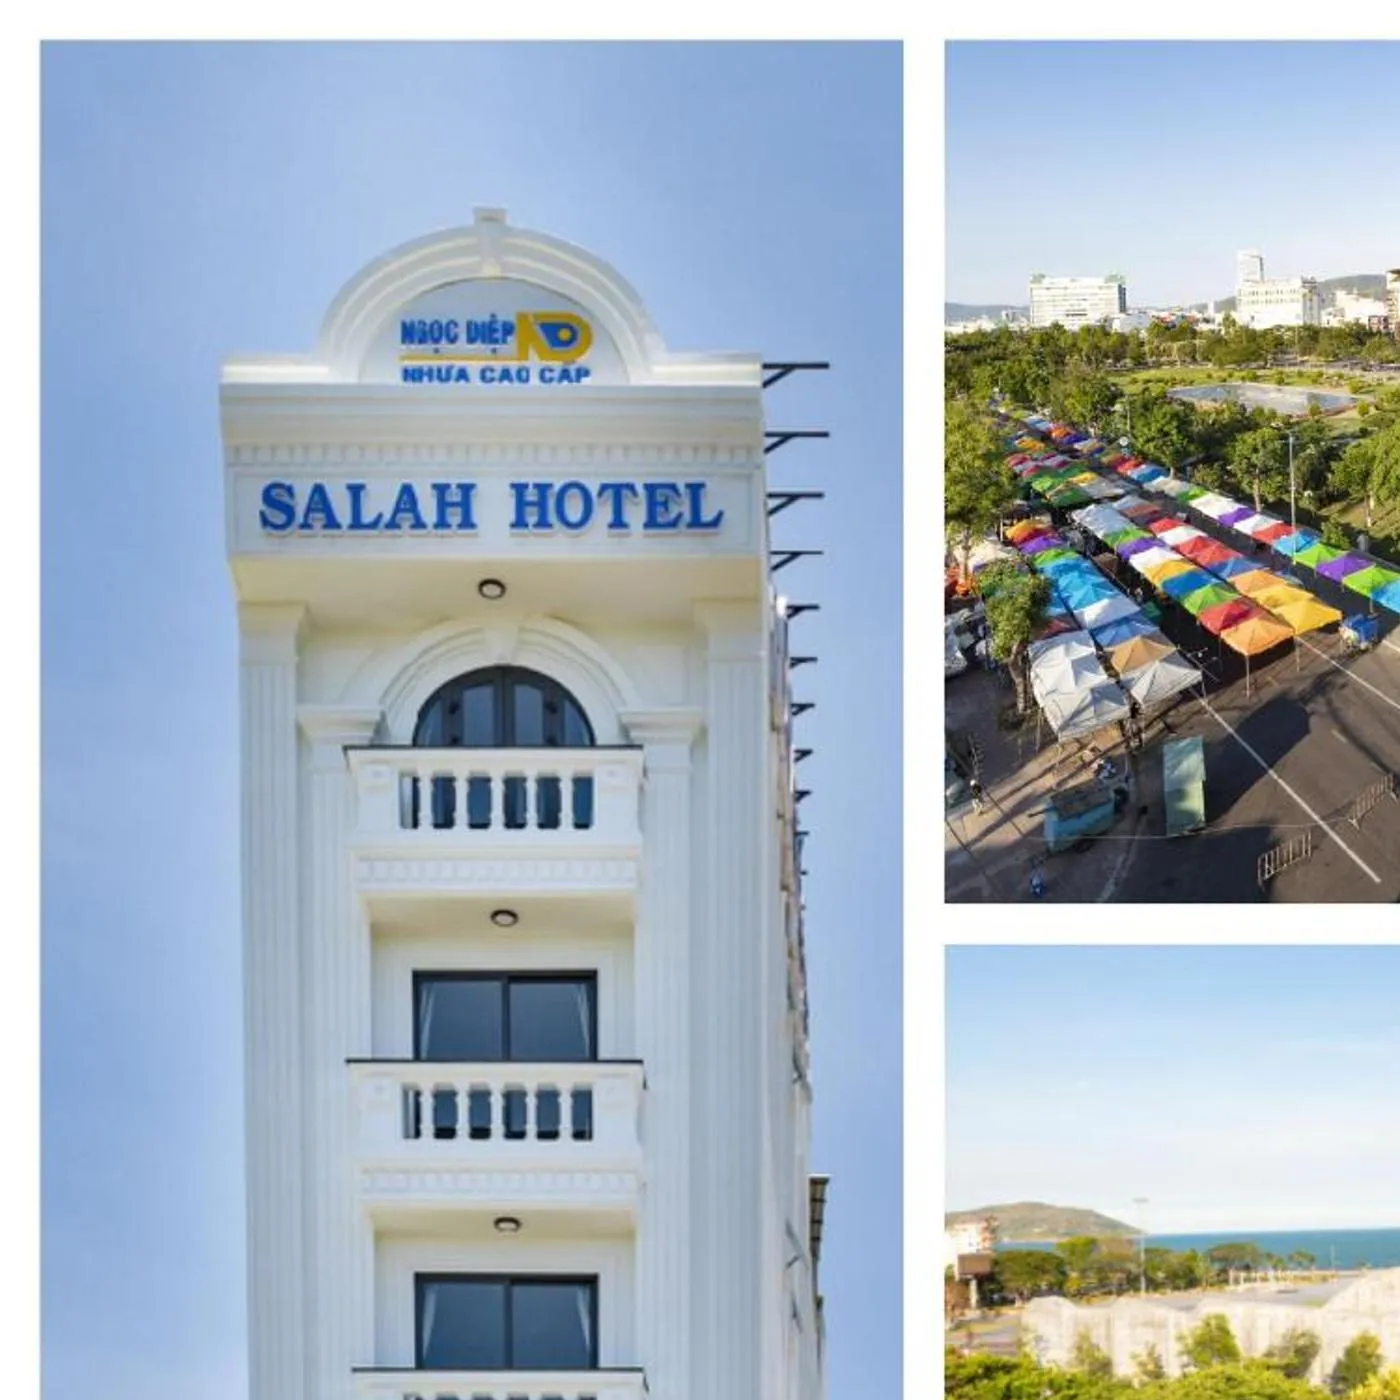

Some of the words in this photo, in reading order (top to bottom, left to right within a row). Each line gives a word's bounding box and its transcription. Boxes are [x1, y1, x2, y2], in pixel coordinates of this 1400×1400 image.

[479, 365, 531, 384] CAO
[259, 483, 478, 532] SALAH
[508, 480, 725, 532] HOTEL
